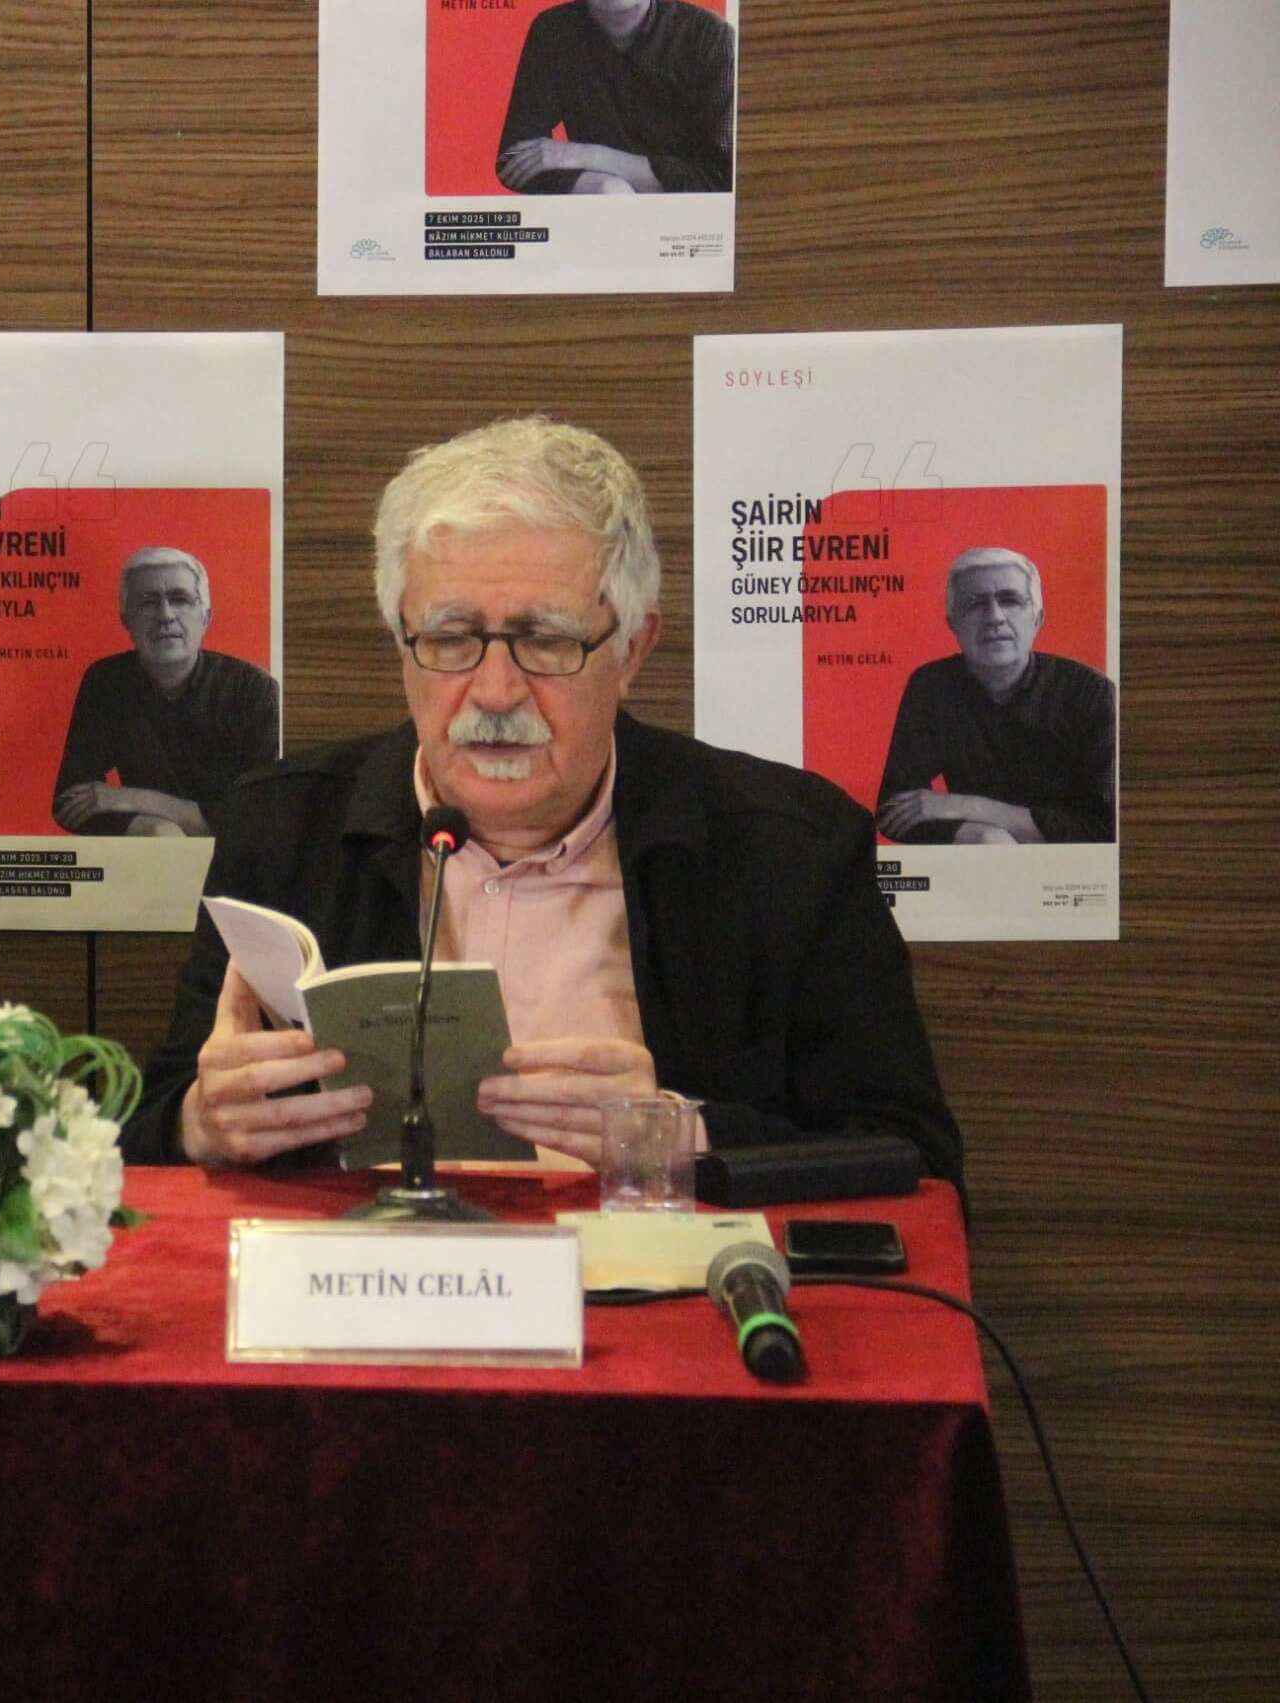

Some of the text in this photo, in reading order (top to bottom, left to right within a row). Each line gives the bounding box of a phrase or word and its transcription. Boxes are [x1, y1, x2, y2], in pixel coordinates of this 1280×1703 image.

[437, 214, 459, 224] EKİM
[462, 214, 484, 223] 2025
[428, 229, 546, 241] NÂZIM HİKMET KÜLTÜREVİ
[428, 248, 509, 257] BALABAN SALONU
[725, 366, 812, 388] SÖYLEŞİ
[731, 492, 822, 533] ŞAİRİN
[731, 527, 889, 570] ŞİİR EVRENİ
[731, 573, 904, 597] GÜNEY ÖZKILINÇ'IN
[731, 605, 857, 624] SORULARIYLA
[857, 652, 894, 664] CELÂL
[19, 853, 41, 862] 2025
[30, 886, 66, 895] SALONU
[309, 1268, 512, 1298] METİN CELÂL
